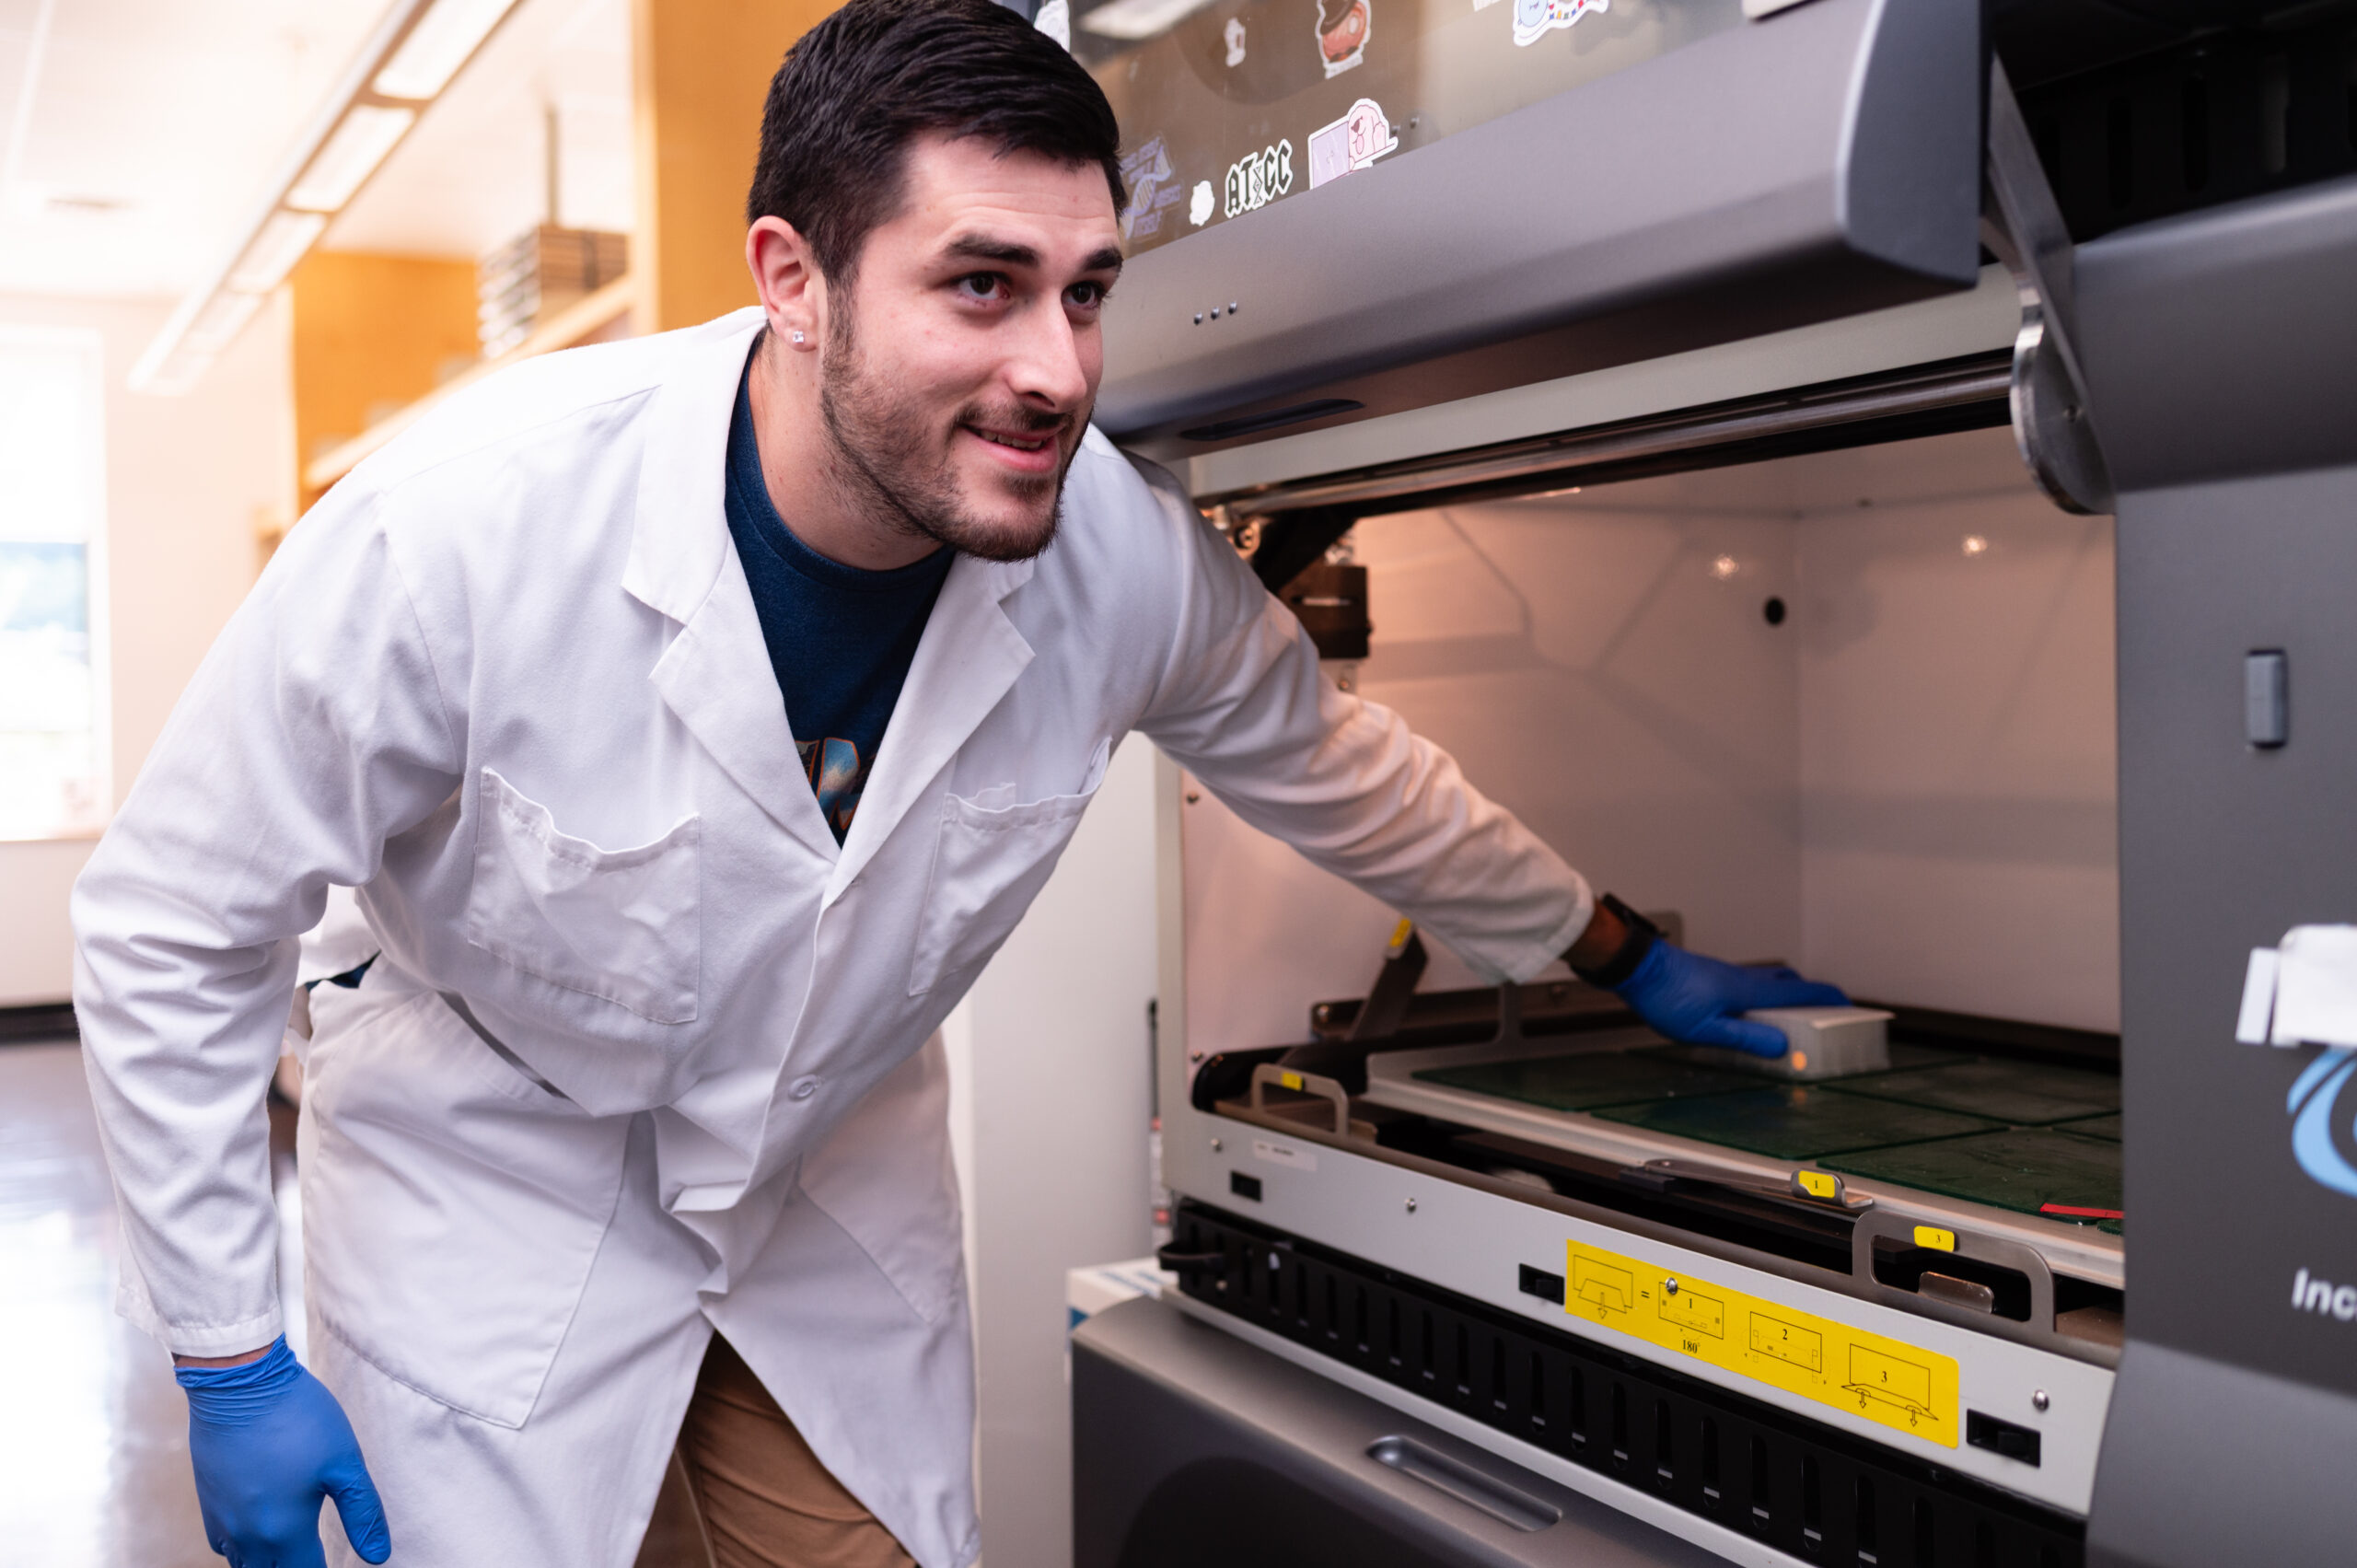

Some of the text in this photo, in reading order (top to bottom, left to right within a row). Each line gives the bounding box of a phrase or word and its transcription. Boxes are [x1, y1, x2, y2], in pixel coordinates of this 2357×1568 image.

[2291, 1267, 2357, 1321] Inc
[1782, 1328, 1788, 1341] 2
[1880, 1370, 1887, 1383] 3
